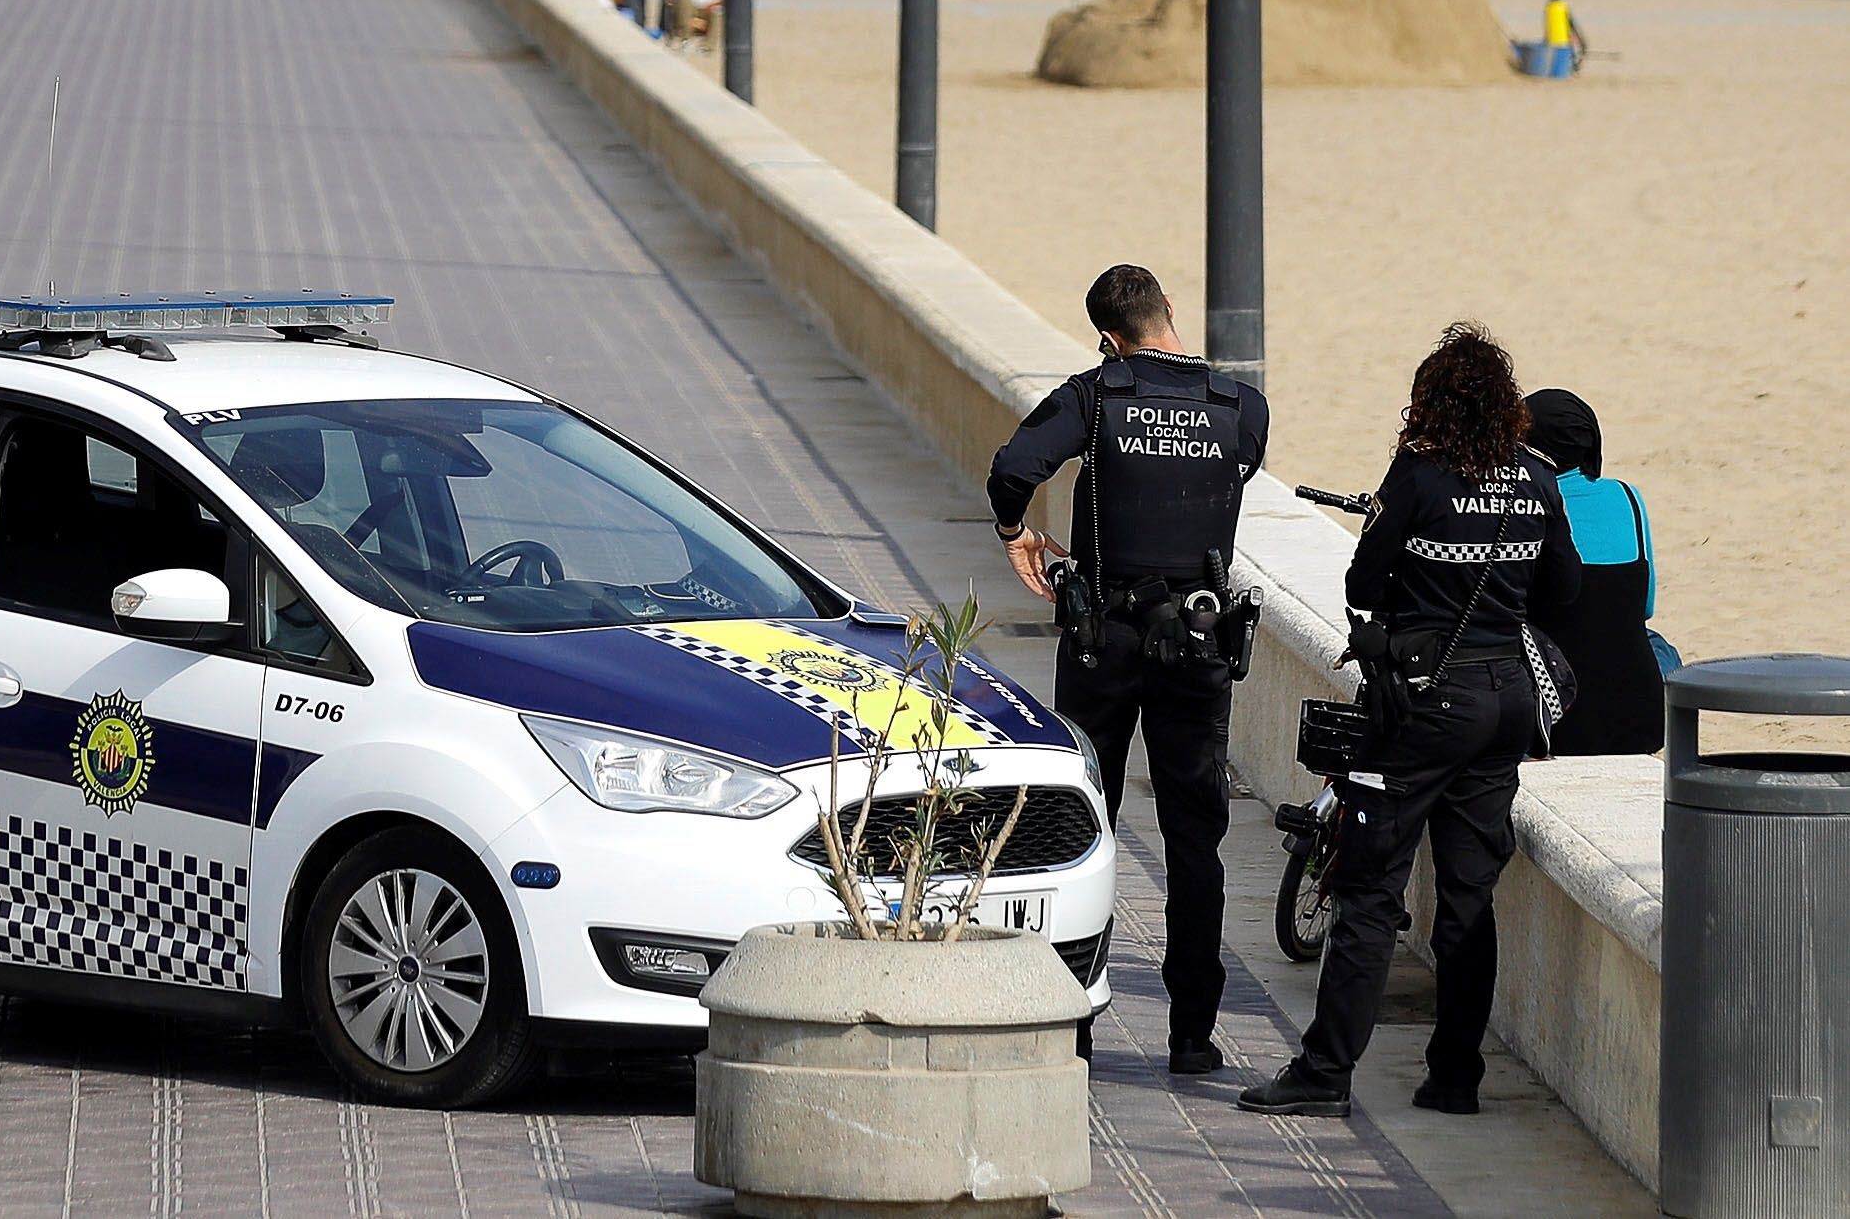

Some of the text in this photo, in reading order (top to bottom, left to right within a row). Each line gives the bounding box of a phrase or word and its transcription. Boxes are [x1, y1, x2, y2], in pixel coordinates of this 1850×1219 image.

[182, 409, 242, 426] PLV
[1126, 406, 1212, 428] POLICIA
[1146, 426, 1189, 439] LOCAL
[1117, 436, 1224, 459] VALENCIA
[274, 693, 345, 723] D7-06
[87, 708, 143, 741] POLICIA LOCAL
